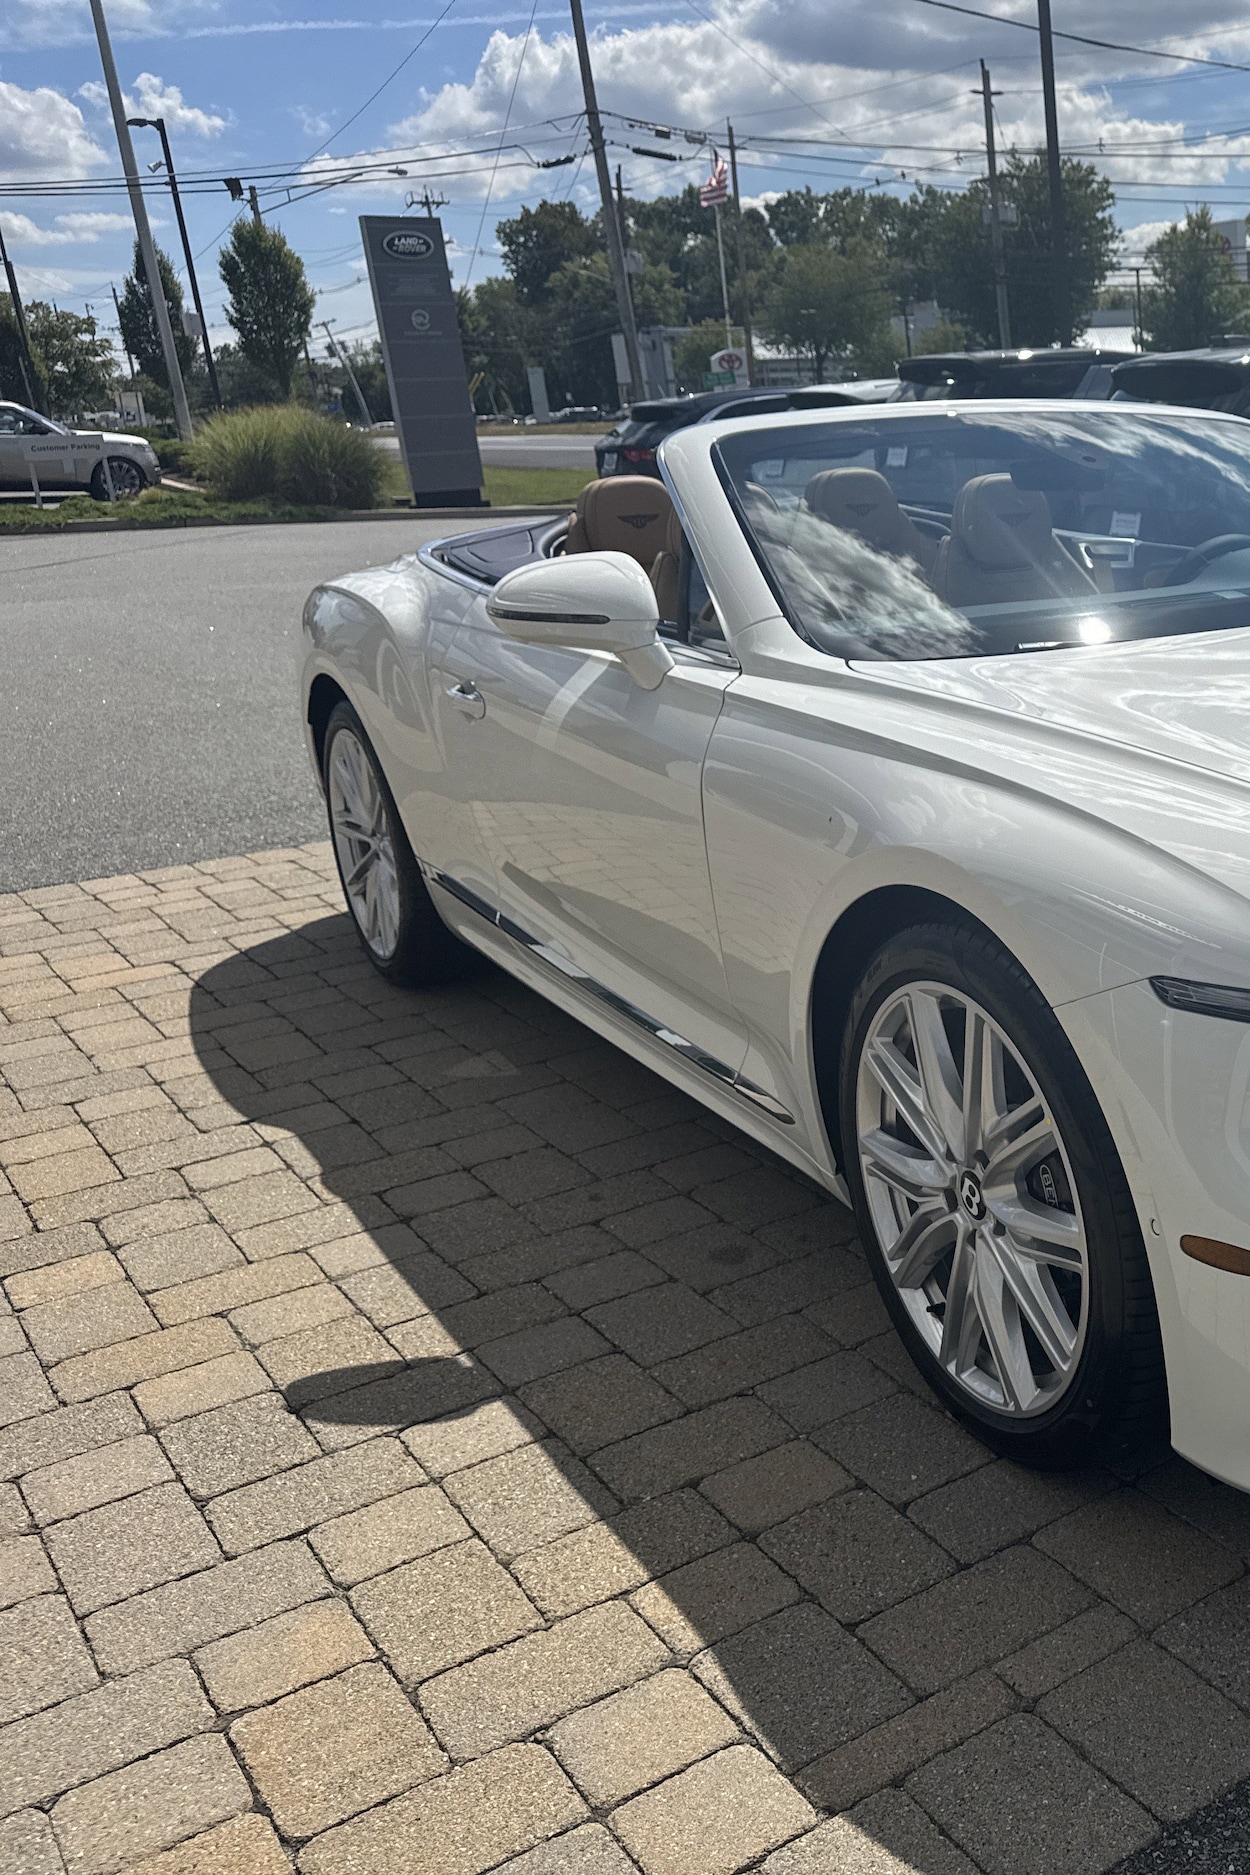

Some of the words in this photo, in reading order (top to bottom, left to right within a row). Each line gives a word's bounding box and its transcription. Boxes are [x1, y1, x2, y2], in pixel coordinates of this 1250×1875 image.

[394, 237, 419, 246] LAND
[398, 244, 427, 253] ROVER
[31, 444, 69, 452] Customer
[71, 443, 100, 451] Parking
[961, 1177, 981, 1216] B
